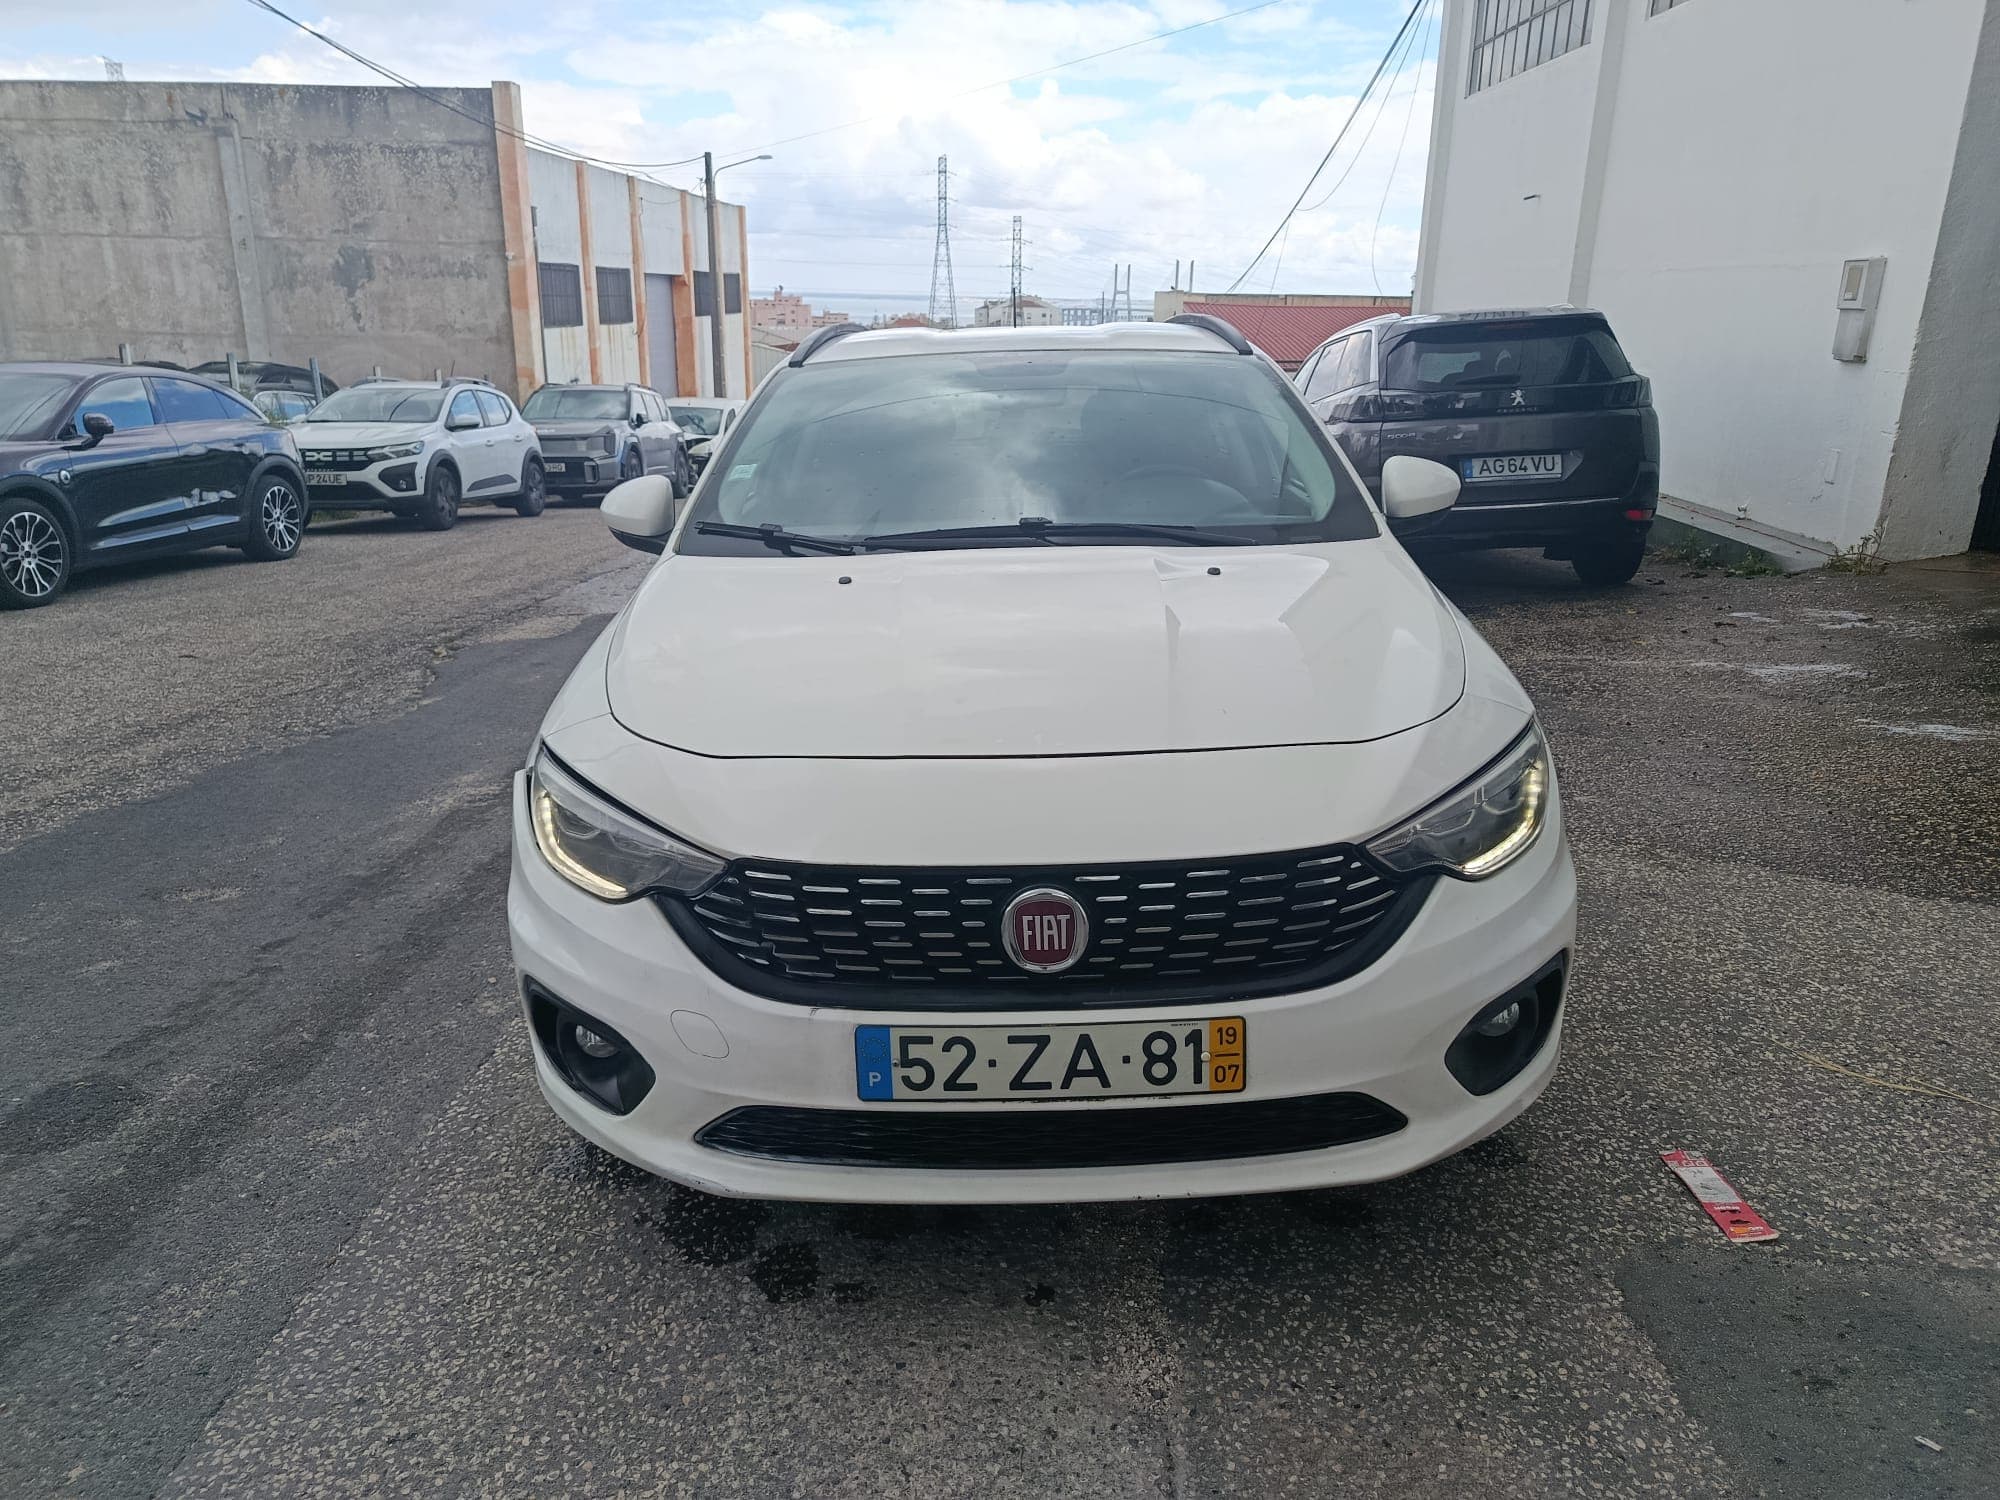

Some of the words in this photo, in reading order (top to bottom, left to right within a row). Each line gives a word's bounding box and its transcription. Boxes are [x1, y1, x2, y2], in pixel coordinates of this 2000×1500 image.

[1022, 914, 1070, 951] FIAT
[1216, 1026, 1237, 1046] 19
[868, 1072, 881, 1087] P
[1214, 1064, 1240, 1083] 07
